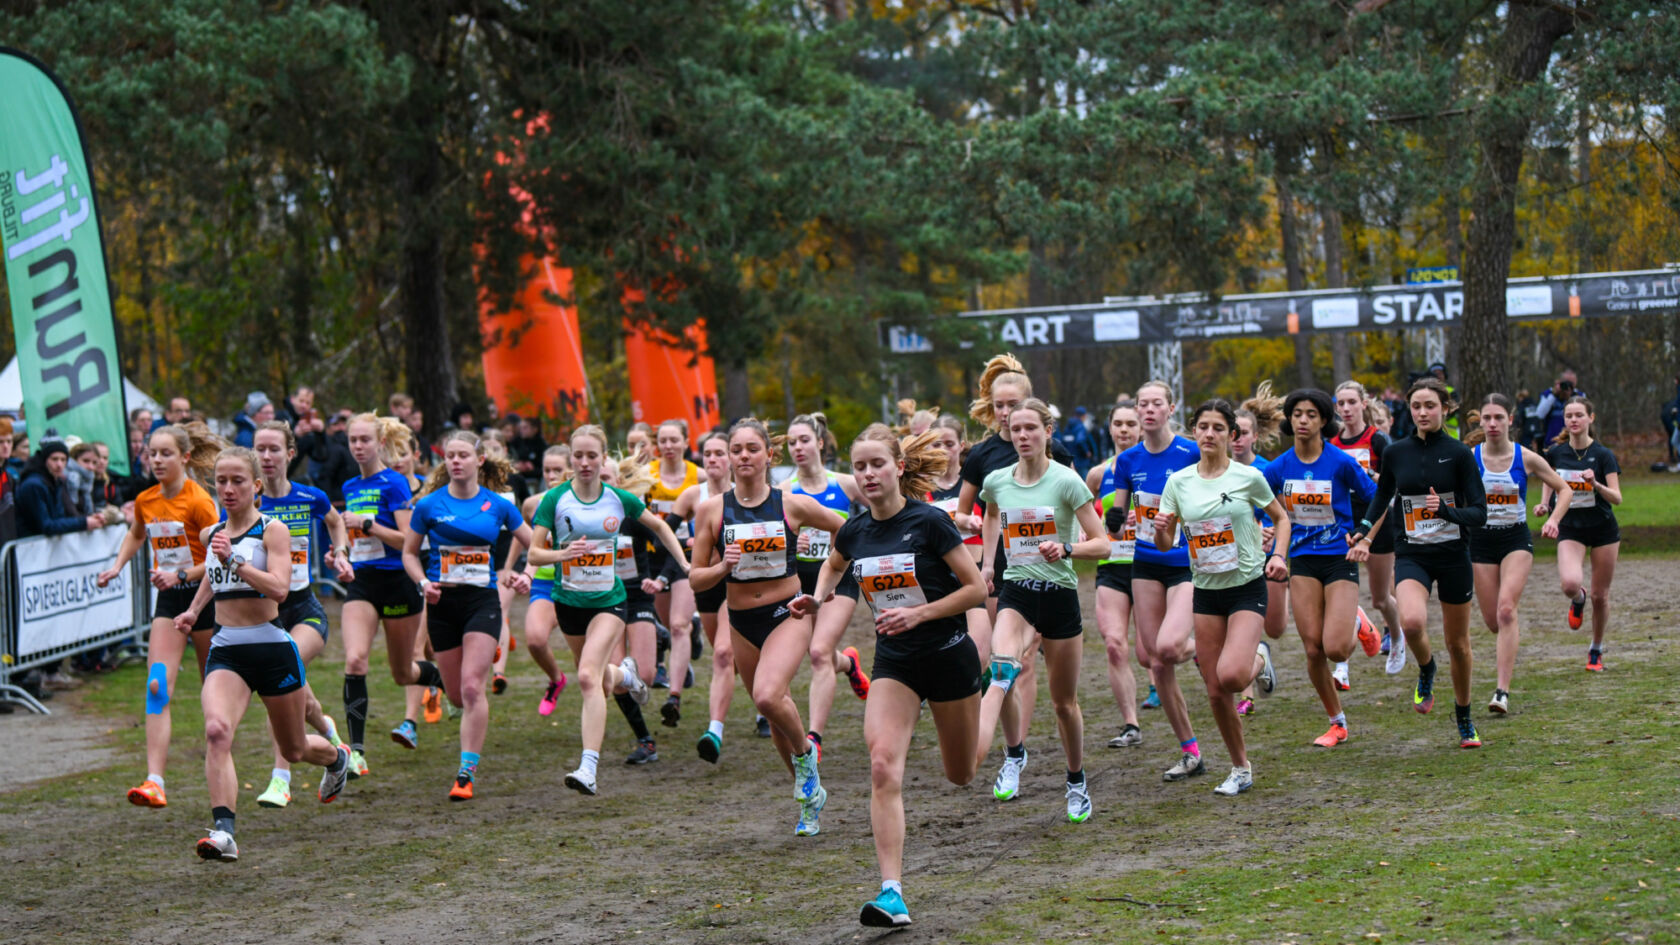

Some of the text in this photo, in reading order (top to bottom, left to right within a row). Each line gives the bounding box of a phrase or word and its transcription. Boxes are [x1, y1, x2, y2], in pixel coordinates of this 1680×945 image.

[1373, 291, 1464, 325] STAR
[980, 315, 1071, 347] ART
[1298, 494, 1325, 505] 602
[1487, 494, 1510, 504] 601
[1018, 523, 1046, 537] 617
[157, 536, 181, 549] 603
[743, 538, 779, 553] 624
[1199, 531, 1228, 548] 634
[455, 553, 484, 564] 609
[577, 554, 606, 567] 627
[208, 566, 246, 585] 8875
[873, 573, 908, 591] 622
[886, 593, 906, 601] Sien
